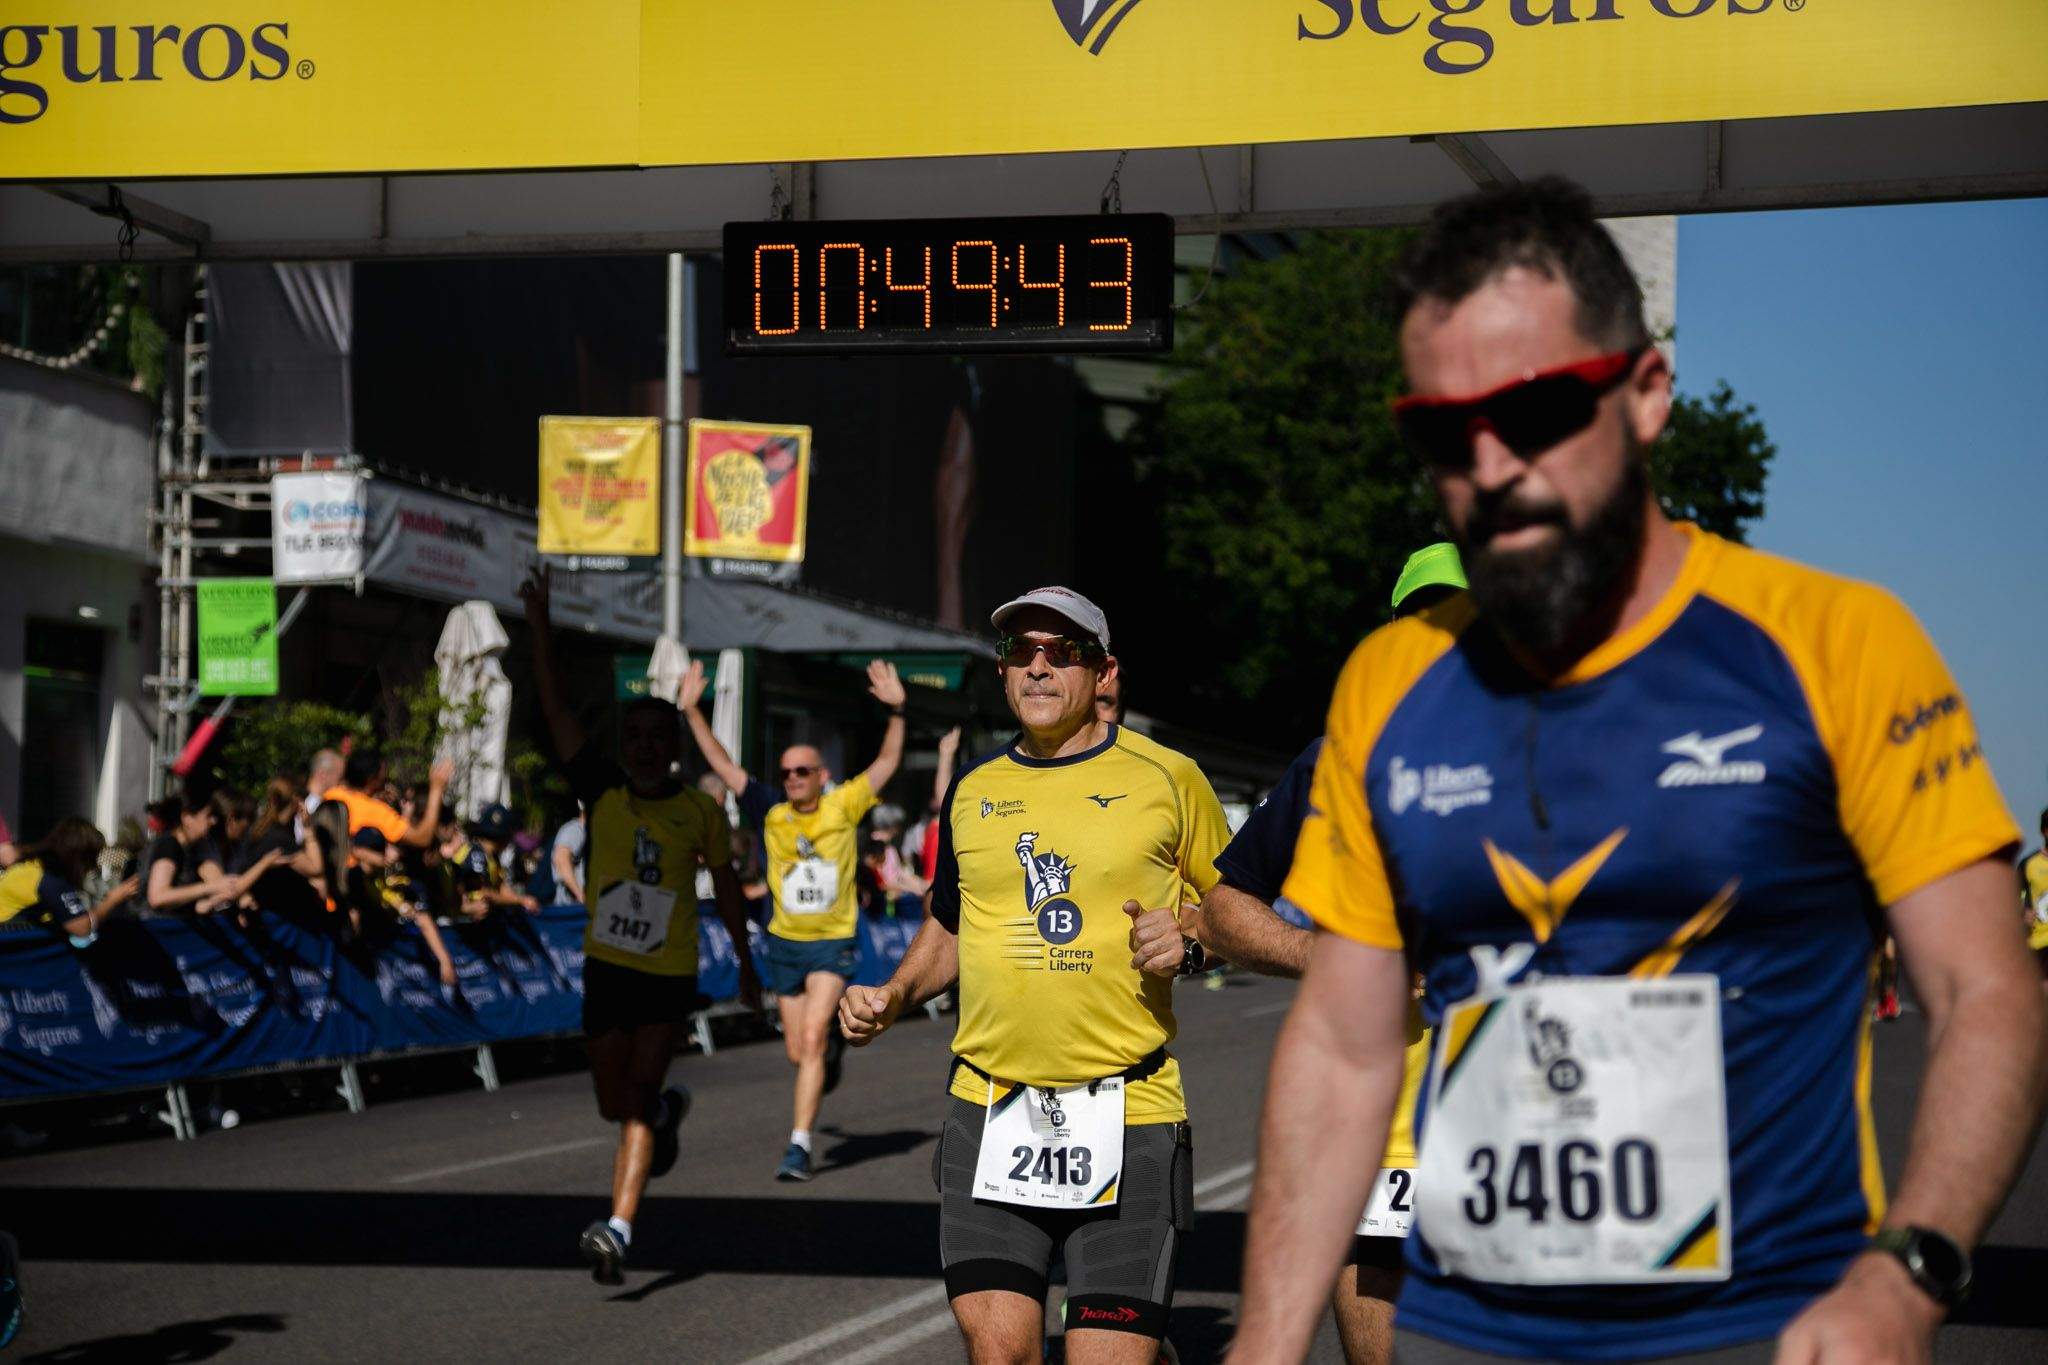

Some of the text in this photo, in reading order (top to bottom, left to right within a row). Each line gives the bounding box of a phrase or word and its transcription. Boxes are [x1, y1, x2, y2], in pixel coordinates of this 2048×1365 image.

[607, 912, 652, 942] 2147
[1046, 910, 1073, 933] 13
[1049, 947, 1093, 959] Carrera
[1049, 959, 1093, 974] Liberty
[1008, 1145, 1092, 1186] 2413
[1388, 1169, 1415, 1212] 2
[1463, 1138, 1661, 1226] 3460
